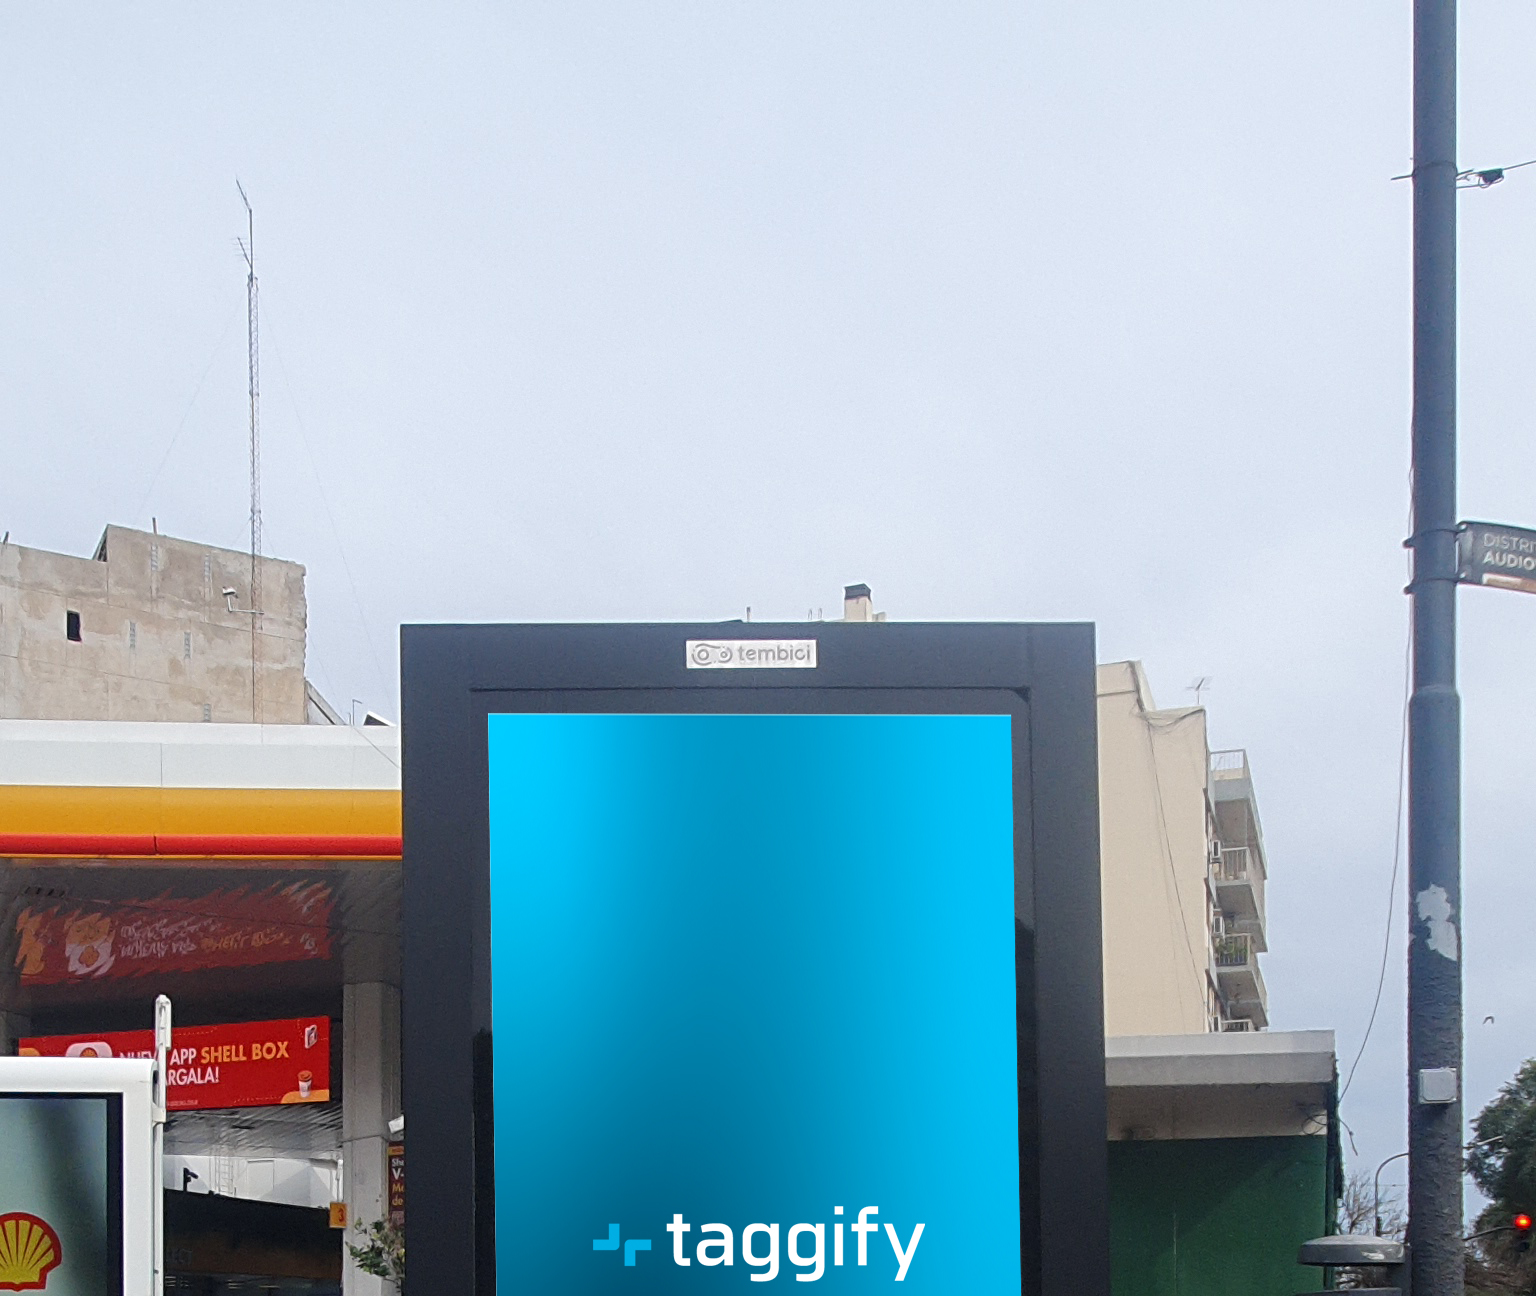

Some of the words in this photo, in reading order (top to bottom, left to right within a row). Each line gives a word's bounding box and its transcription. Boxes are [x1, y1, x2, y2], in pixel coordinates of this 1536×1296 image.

[737, 644, 811, 661] tembici
[169, 1048, 197, 1066] APP
[200, 1044, 247, 1064] SHELL
[251, 1041, 290, 1060] BOX
[165, 1066, 220, 1086] RGALA!
[666, 1206, 926, 1282] taggify
